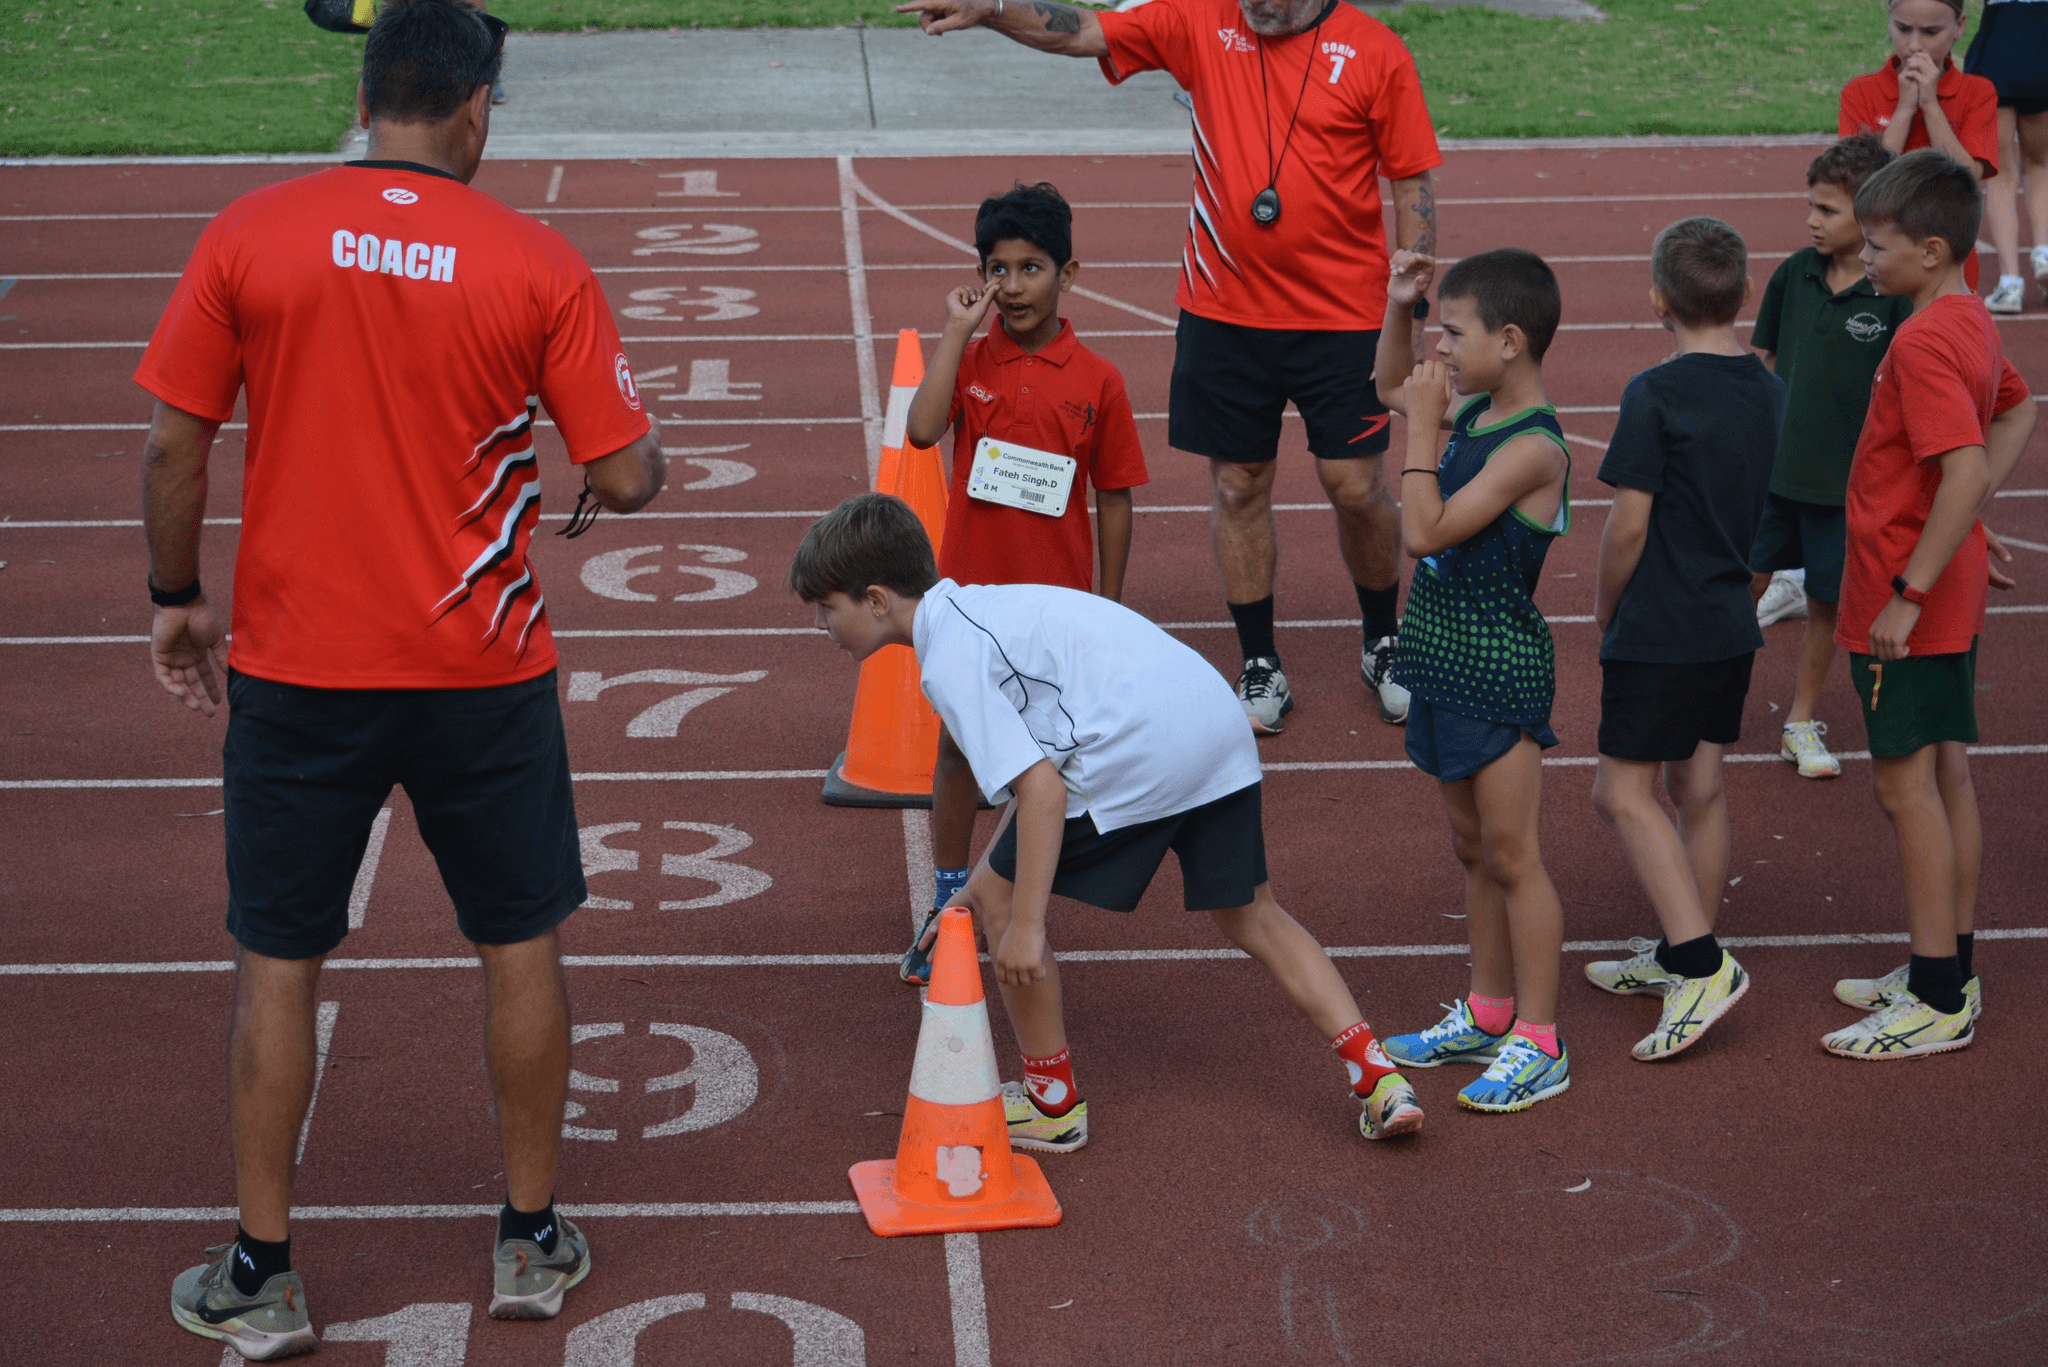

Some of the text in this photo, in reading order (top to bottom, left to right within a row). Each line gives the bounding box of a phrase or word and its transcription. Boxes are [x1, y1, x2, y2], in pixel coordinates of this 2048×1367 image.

[1328, 55, 1346, 84] 7
[656, 170, 741, 197] 1
[332, 229, 457, 283] COACH
[631, 224, 762, 256] 2
[620, 286, 761, 321] 3
[636, 360, 763, 401] 4
[993, 467, 1020, 480] Fateh
[1021, 474, 1058, 488] Singh.D
[1002, 452, 1049, 470] Commonwealth
[1050, 463, 1065, 473] Bank
[580, 544, 759, 602] 6
[567, 669, 770, 738] 7
[577, 821, 774, 911] 8
[561, 1021, 759, 1142] 9
